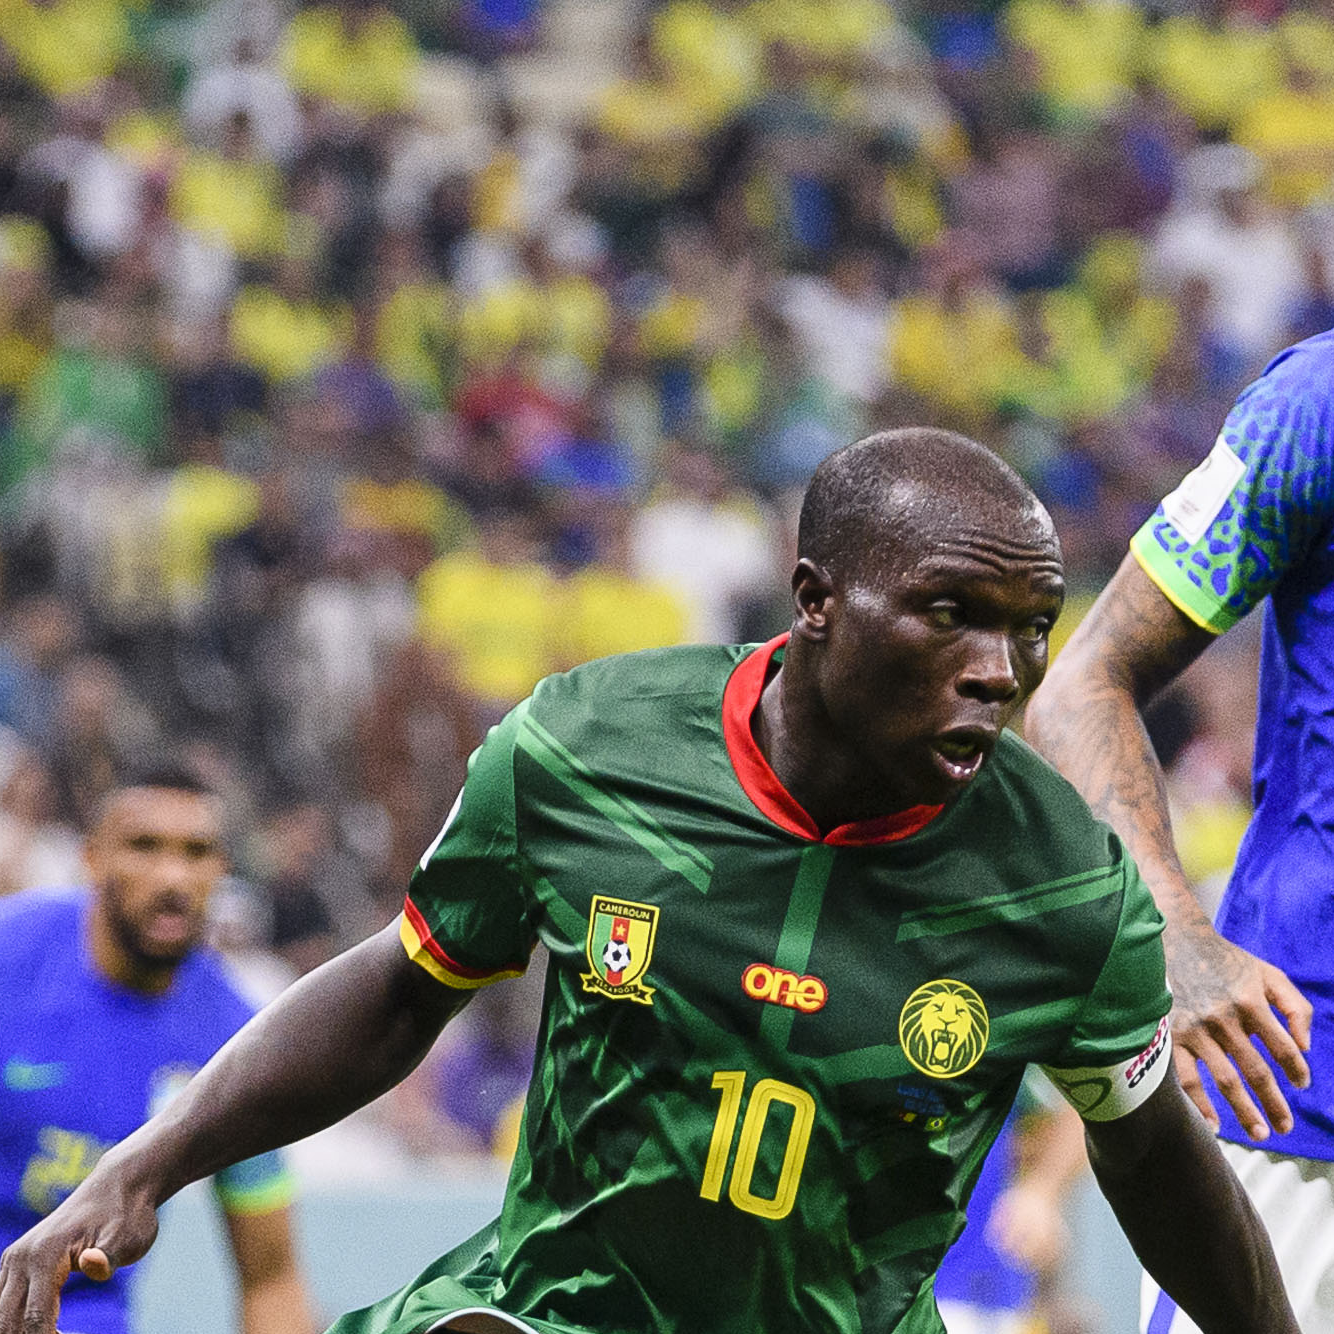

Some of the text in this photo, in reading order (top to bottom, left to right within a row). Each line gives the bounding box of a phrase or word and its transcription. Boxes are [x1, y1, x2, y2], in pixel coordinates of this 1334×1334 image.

[599, 902, 650, 920] CAMEROUN
[744, 966, 825, 1010] one
[699, 1070, 816, 1221] 10
